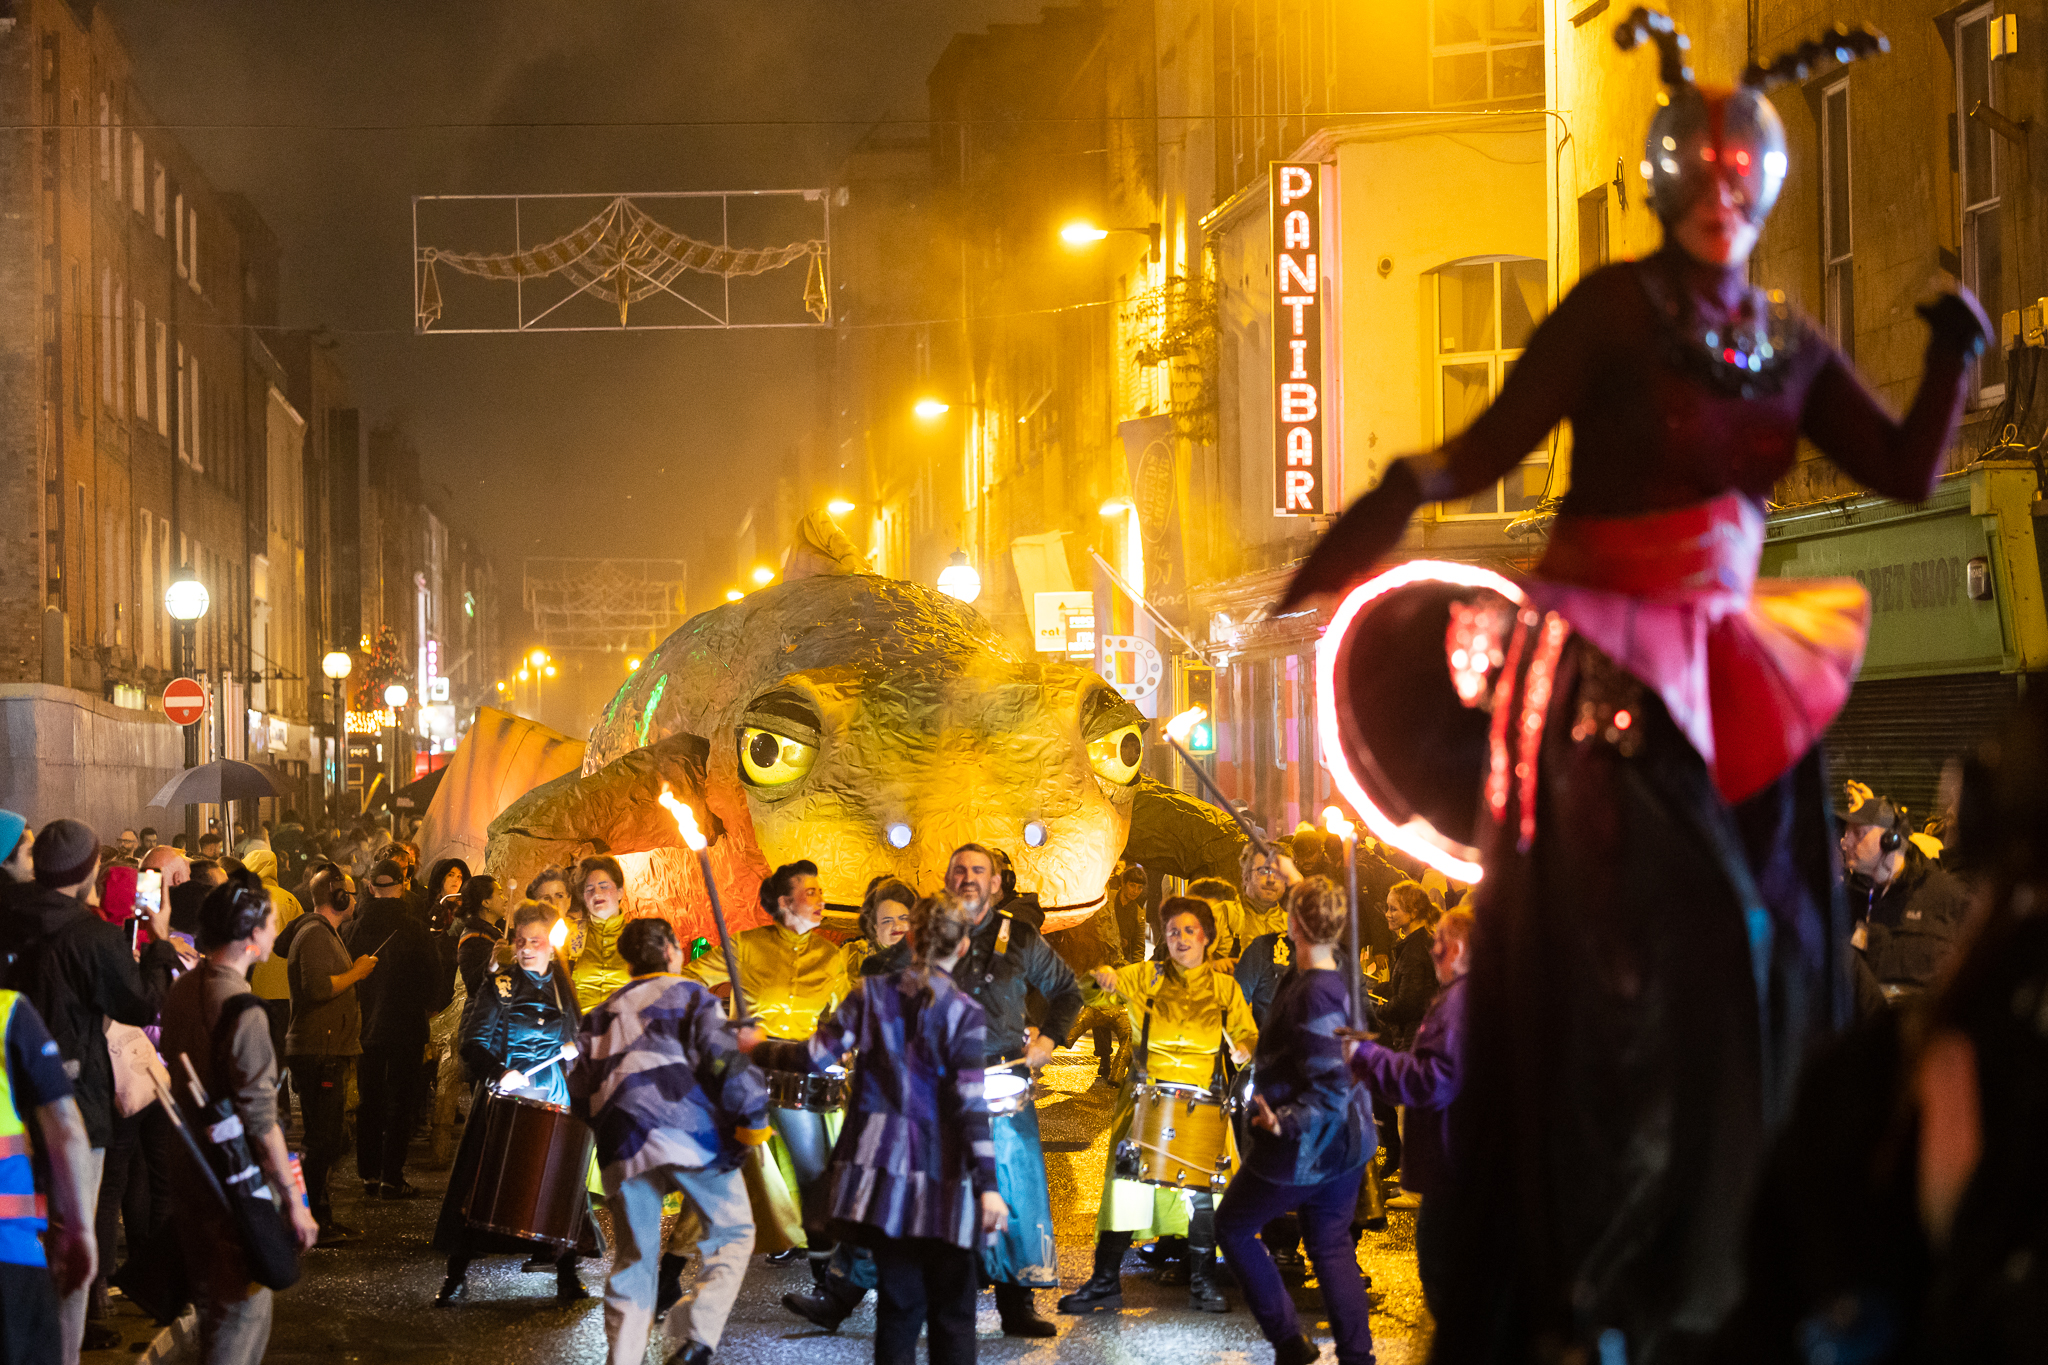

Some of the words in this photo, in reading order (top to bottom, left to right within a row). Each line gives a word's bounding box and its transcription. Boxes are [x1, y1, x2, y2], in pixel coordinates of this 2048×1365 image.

[1278, 165, 1318, 511] PANTIBAR
[1870, 563, 1905, 613] PET
[1910, 556, 1960, 609] SHOP
[1041, 626, 1060, 637] eat
